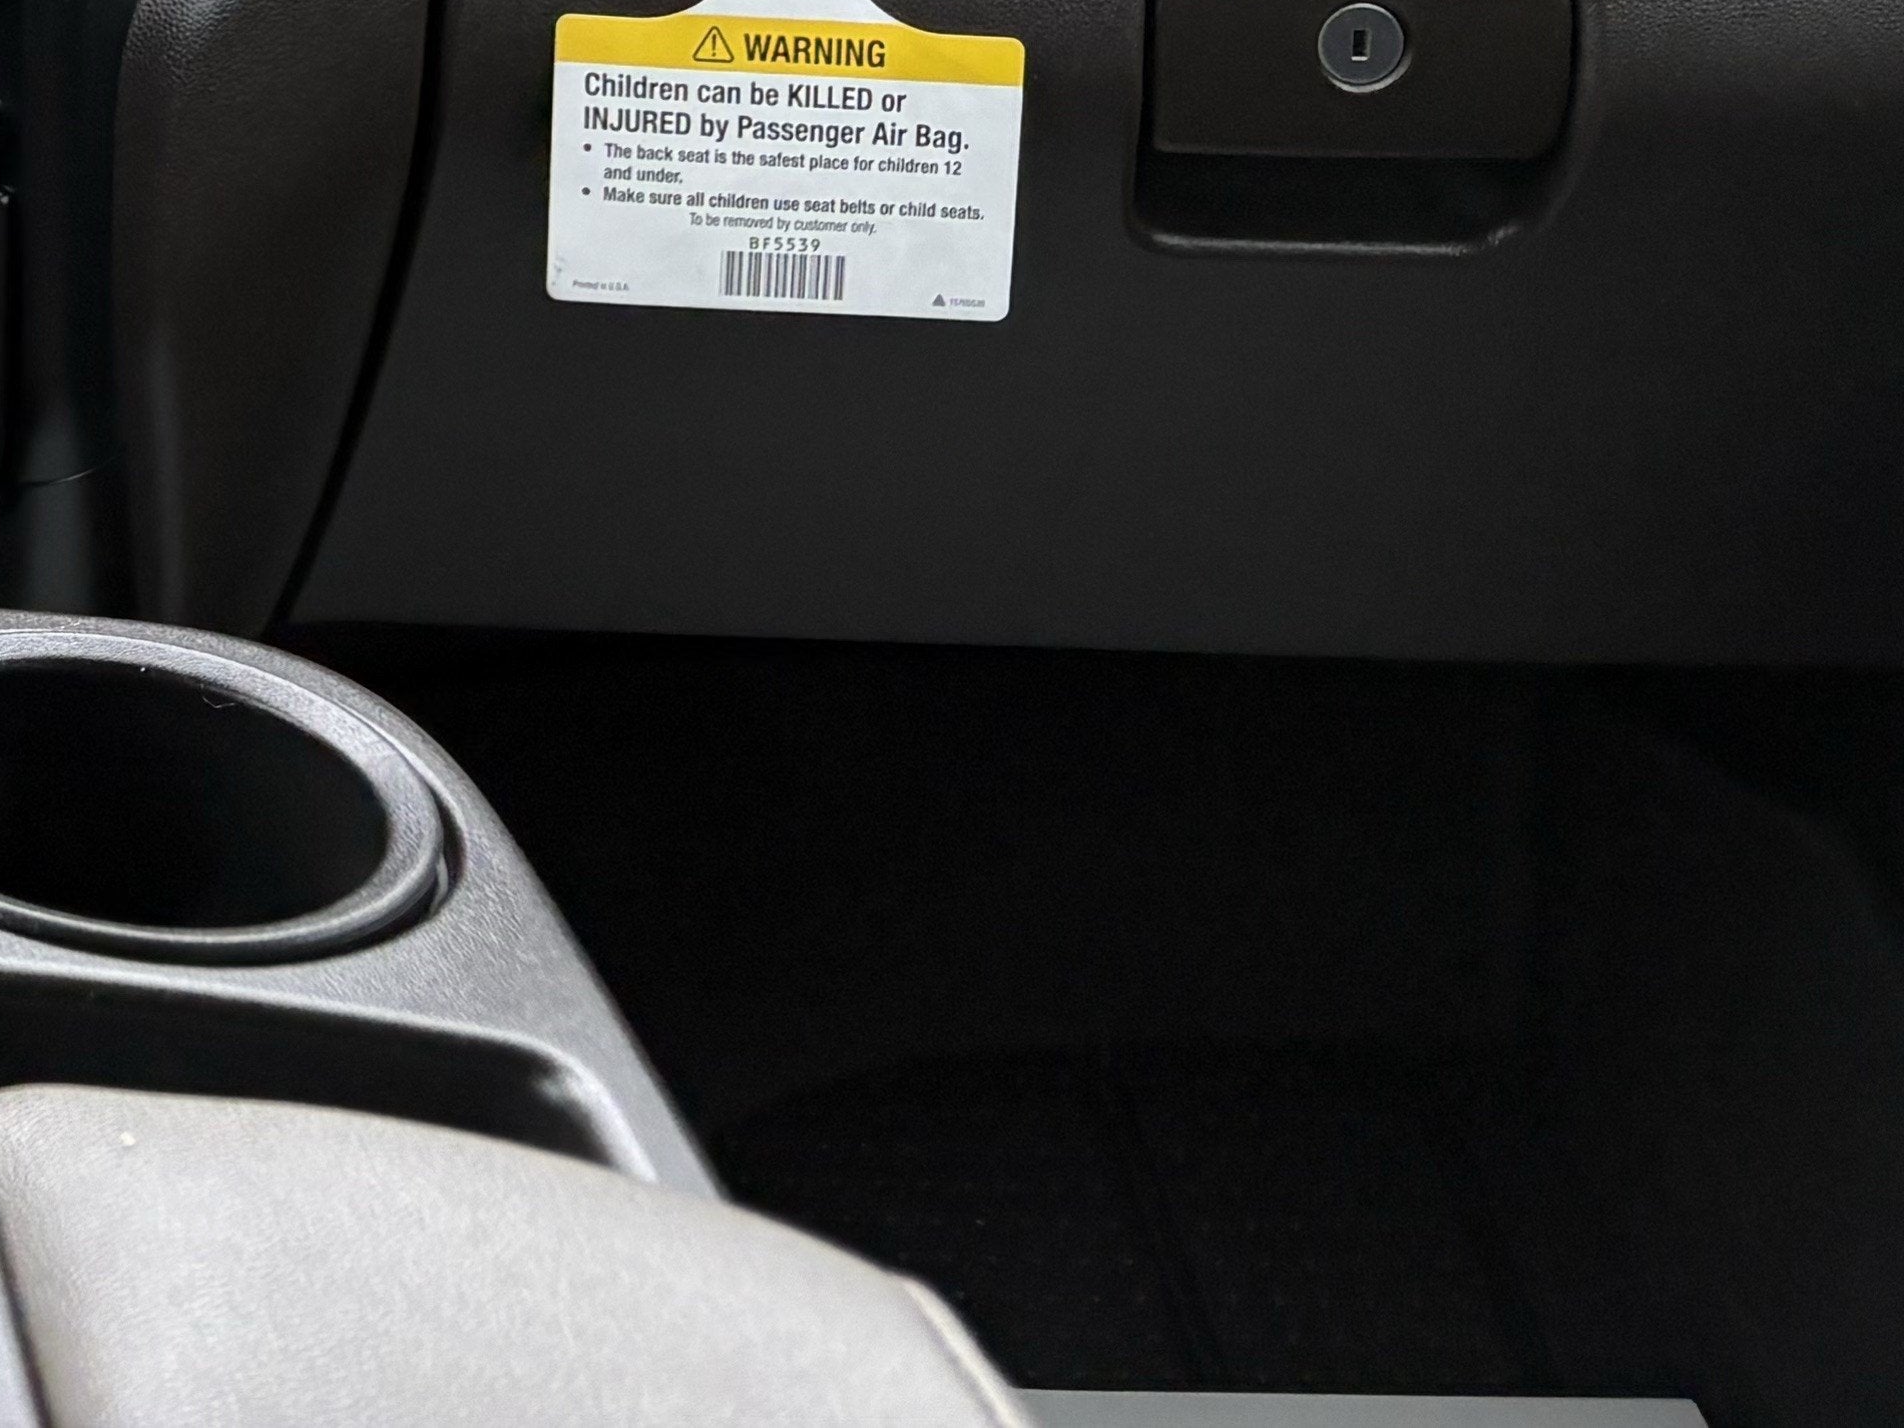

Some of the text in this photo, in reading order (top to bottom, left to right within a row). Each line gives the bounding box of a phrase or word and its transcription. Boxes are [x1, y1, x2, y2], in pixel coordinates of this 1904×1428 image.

[744, 33, 886, 68] WARNING
[584, 72, 907, 113] Children can be KILLED or
[584, 106, 969, 155] INJURED by Passenger Air Bag.
[603, 166, 683, 184] and under.
[604, 142, 962, 176] The back seat is the safest place for children 12
[603, 186, 985, 221] Make sure all children use seat belts or child seats.
[748, 236, 821, 254] BF5539
